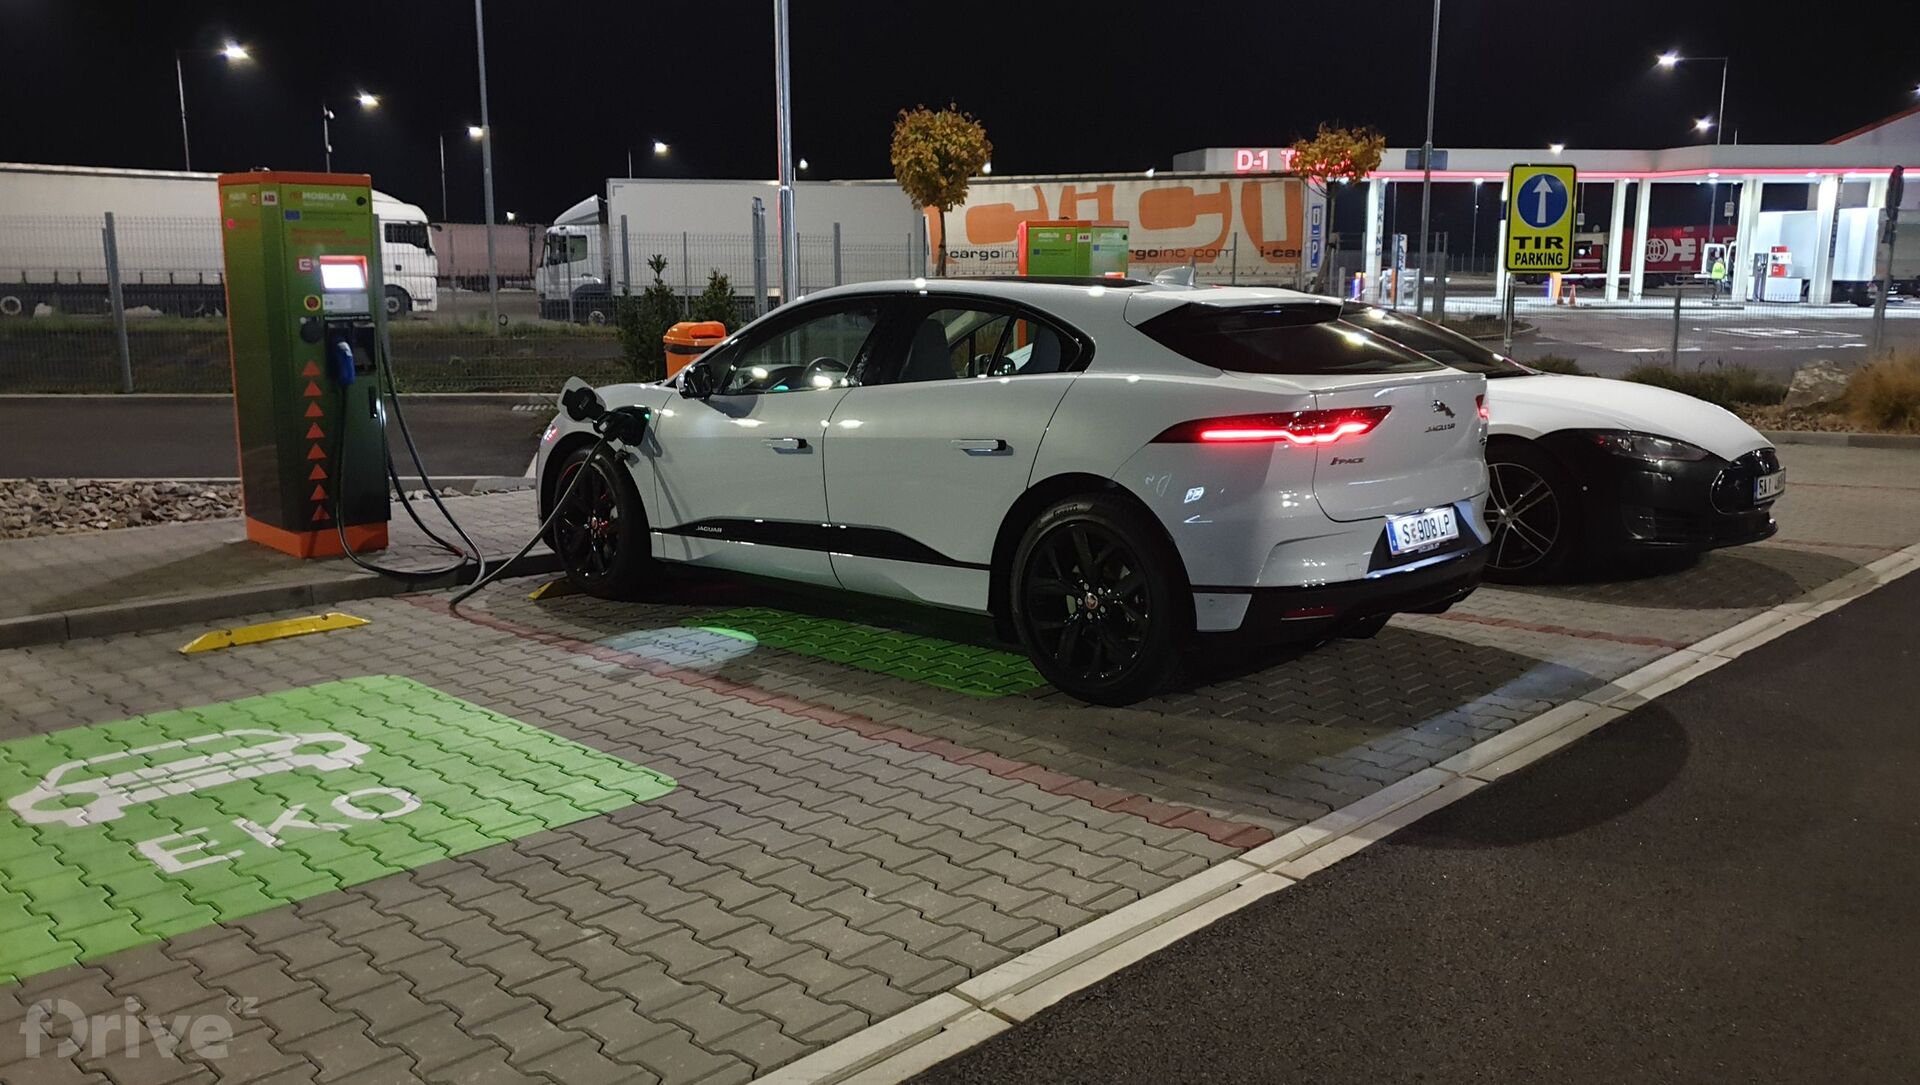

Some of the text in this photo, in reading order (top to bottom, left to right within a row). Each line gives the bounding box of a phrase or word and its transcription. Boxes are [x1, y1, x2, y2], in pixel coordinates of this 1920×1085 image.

[1236, 150, 1269, 171] D-1
[1513, 236, 1564, 250] TIR
[1514, 252, 1563, 266] PARKING
[695, 525, 723, 534] JAGUAR
[136, 787, 423, 874] EKO
